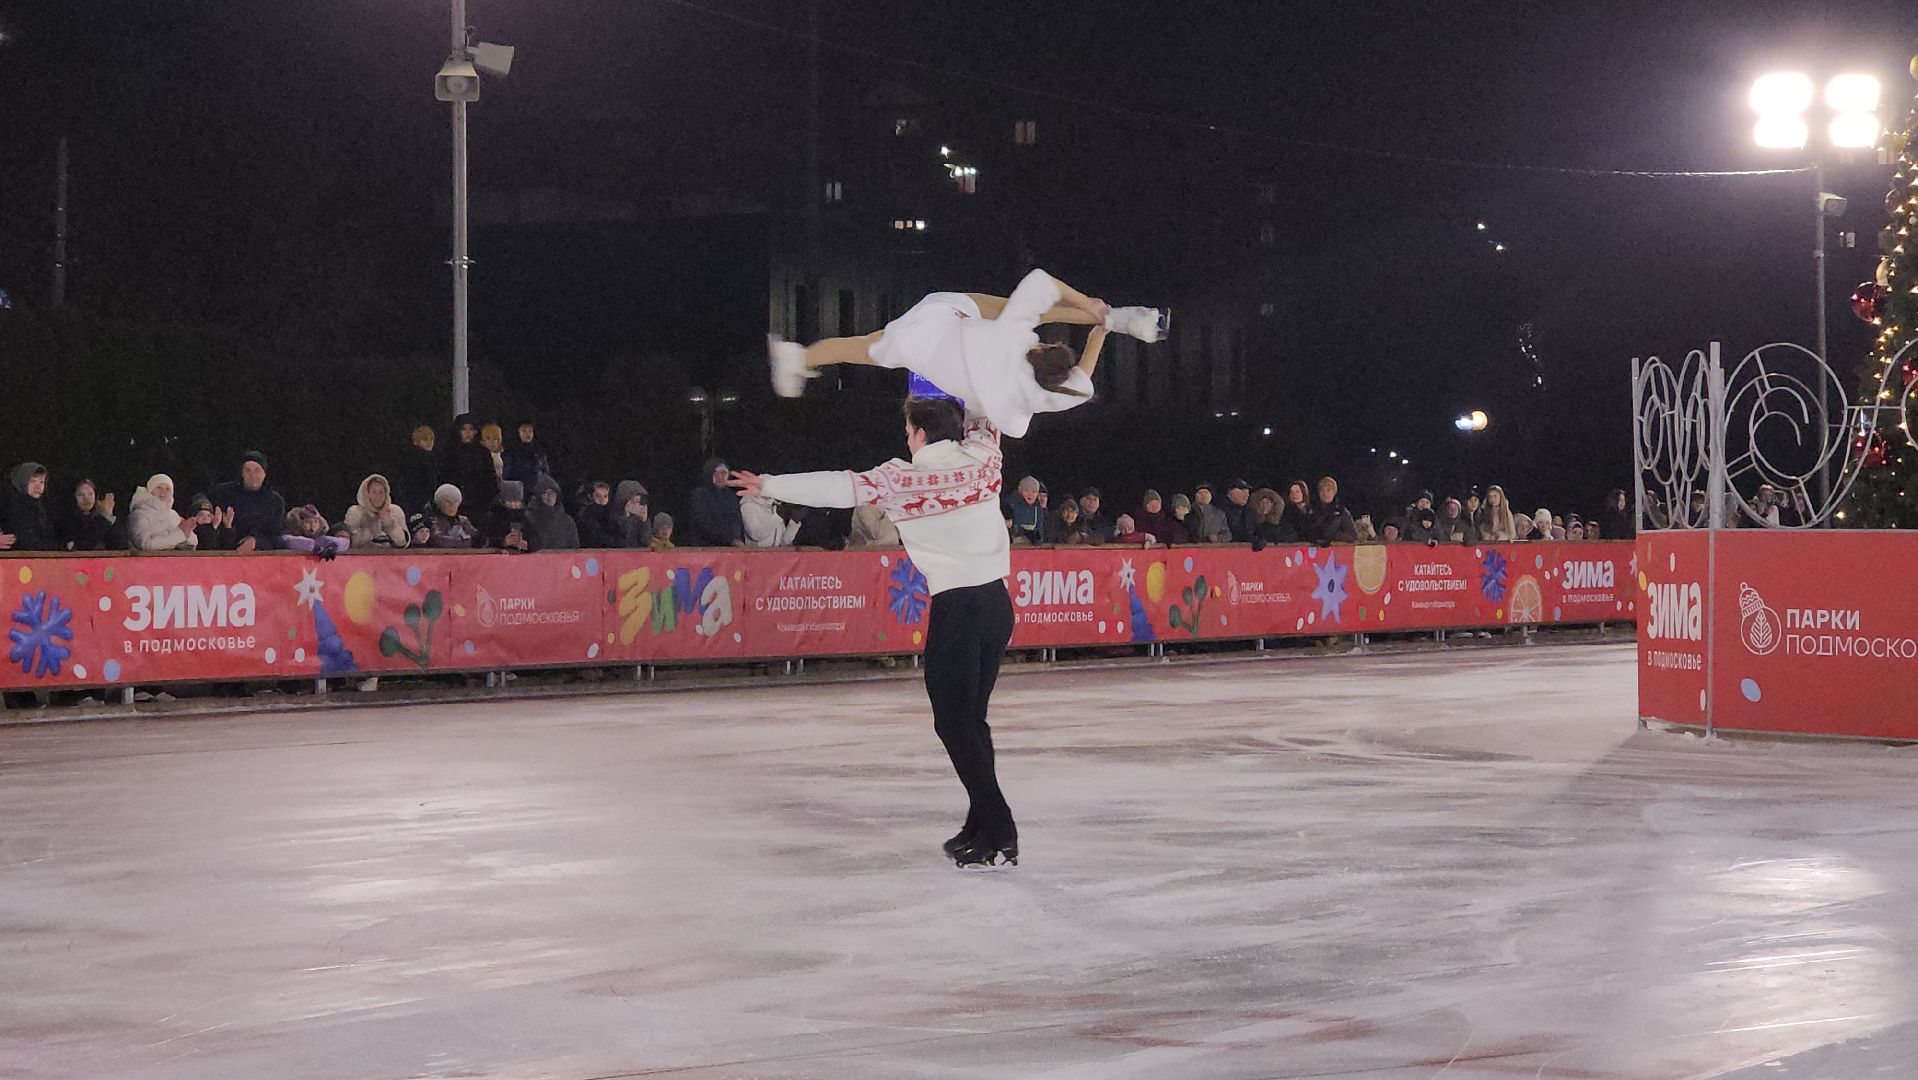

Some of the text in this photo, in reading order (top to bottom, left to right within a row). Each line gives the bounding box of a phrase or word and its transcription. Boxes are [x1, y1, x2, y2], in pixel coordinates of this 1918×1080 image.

[1414, 561, 1453, 576] КАТАЙТЕСЬ
[779, 573, 842, 590] КАТАЙТЕСЬ
[1241, 581, 1264, 592] ПАРКИ
[1398, 580, 1404, 592] С
[500, 597, 535, 610] ПАРКИ
[755, 594, 866, 612] С УДОВОЛЬСТВИЕМ!
[1786, 608, 1860, 631] ПАРКИ
